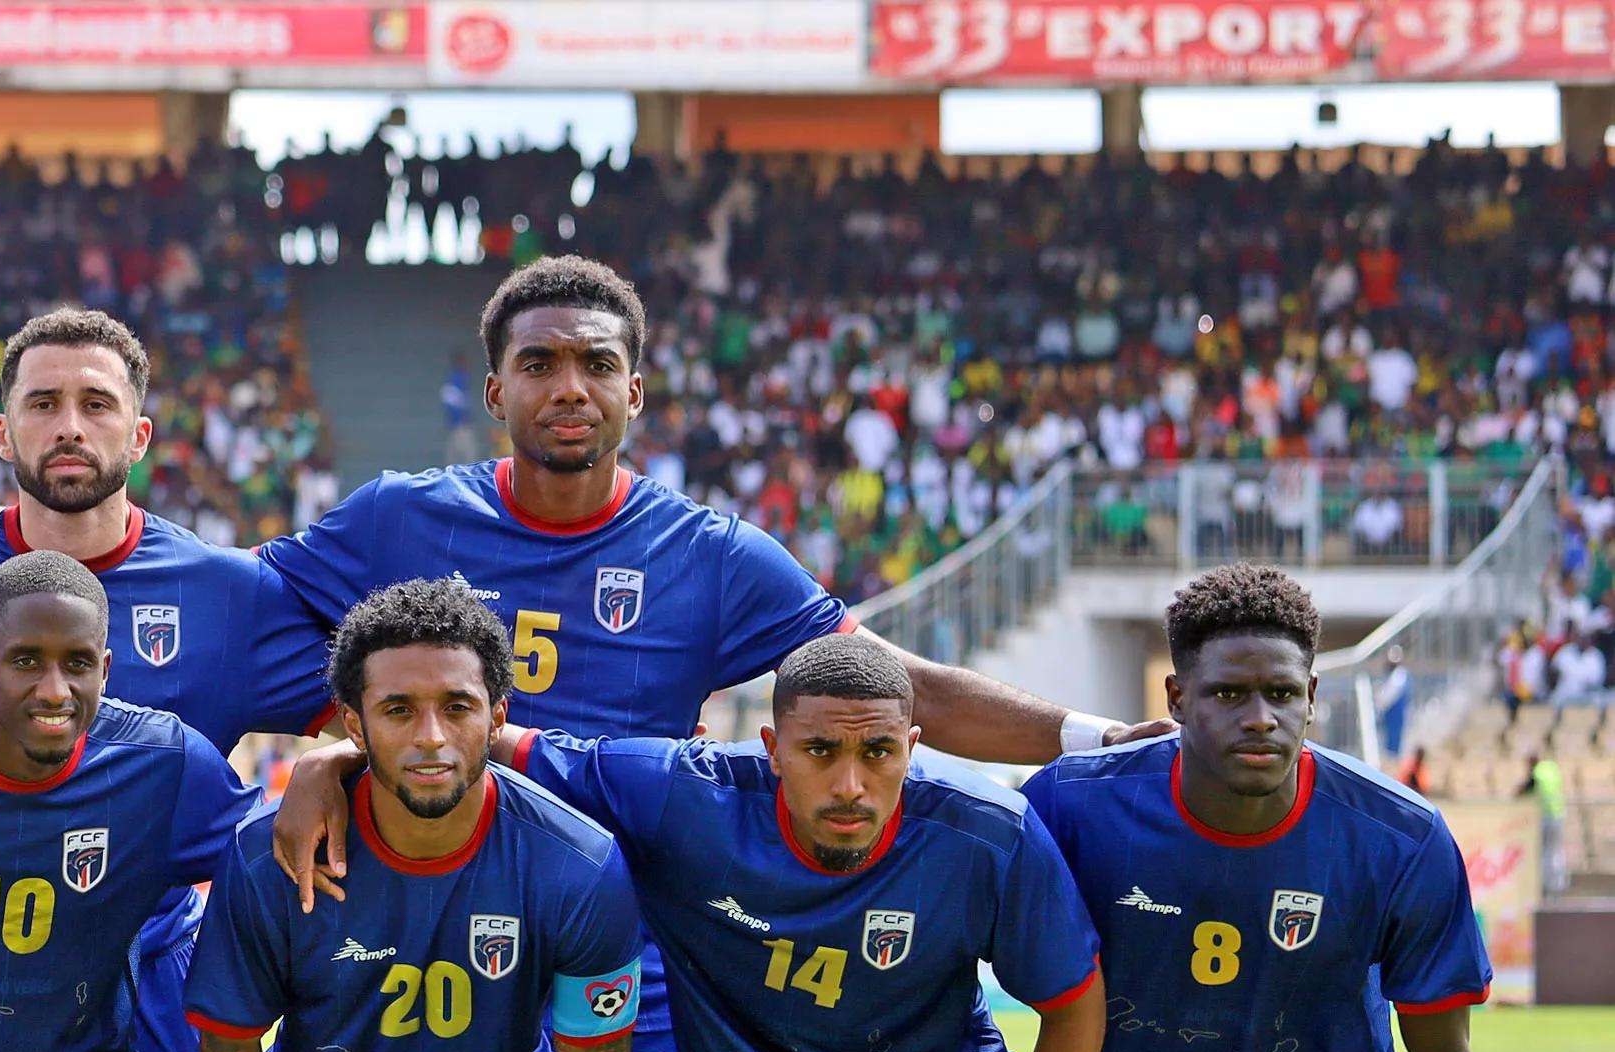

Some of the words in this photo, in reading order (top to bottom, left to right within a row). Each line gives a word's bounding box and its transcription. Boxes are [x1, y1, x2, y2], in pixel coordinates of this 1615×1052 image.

[1046, 5, 1363, 59] EXPORT
[600, 571, 639, 583] FCF
[469, 588, 501, 601] mpo
[137, 608, 175, 618] FCF
[513, 609, 561, 694] 5
[68, 832, 105, 846] FCF
[1278, 894, 1318, 906] FCF
[1138, 901, 1182, 915] tempo
[474, 919, 516, 930] FCF
[727, 908, 771, 932] tempo
[869, 914, 910, 924] FCF
[353, 946, 396, 962] tempo
[1190, 920, 1242, 986] 8
[762, 938, 849, 1009] 14
[380, 961, 472, 1038] 20
